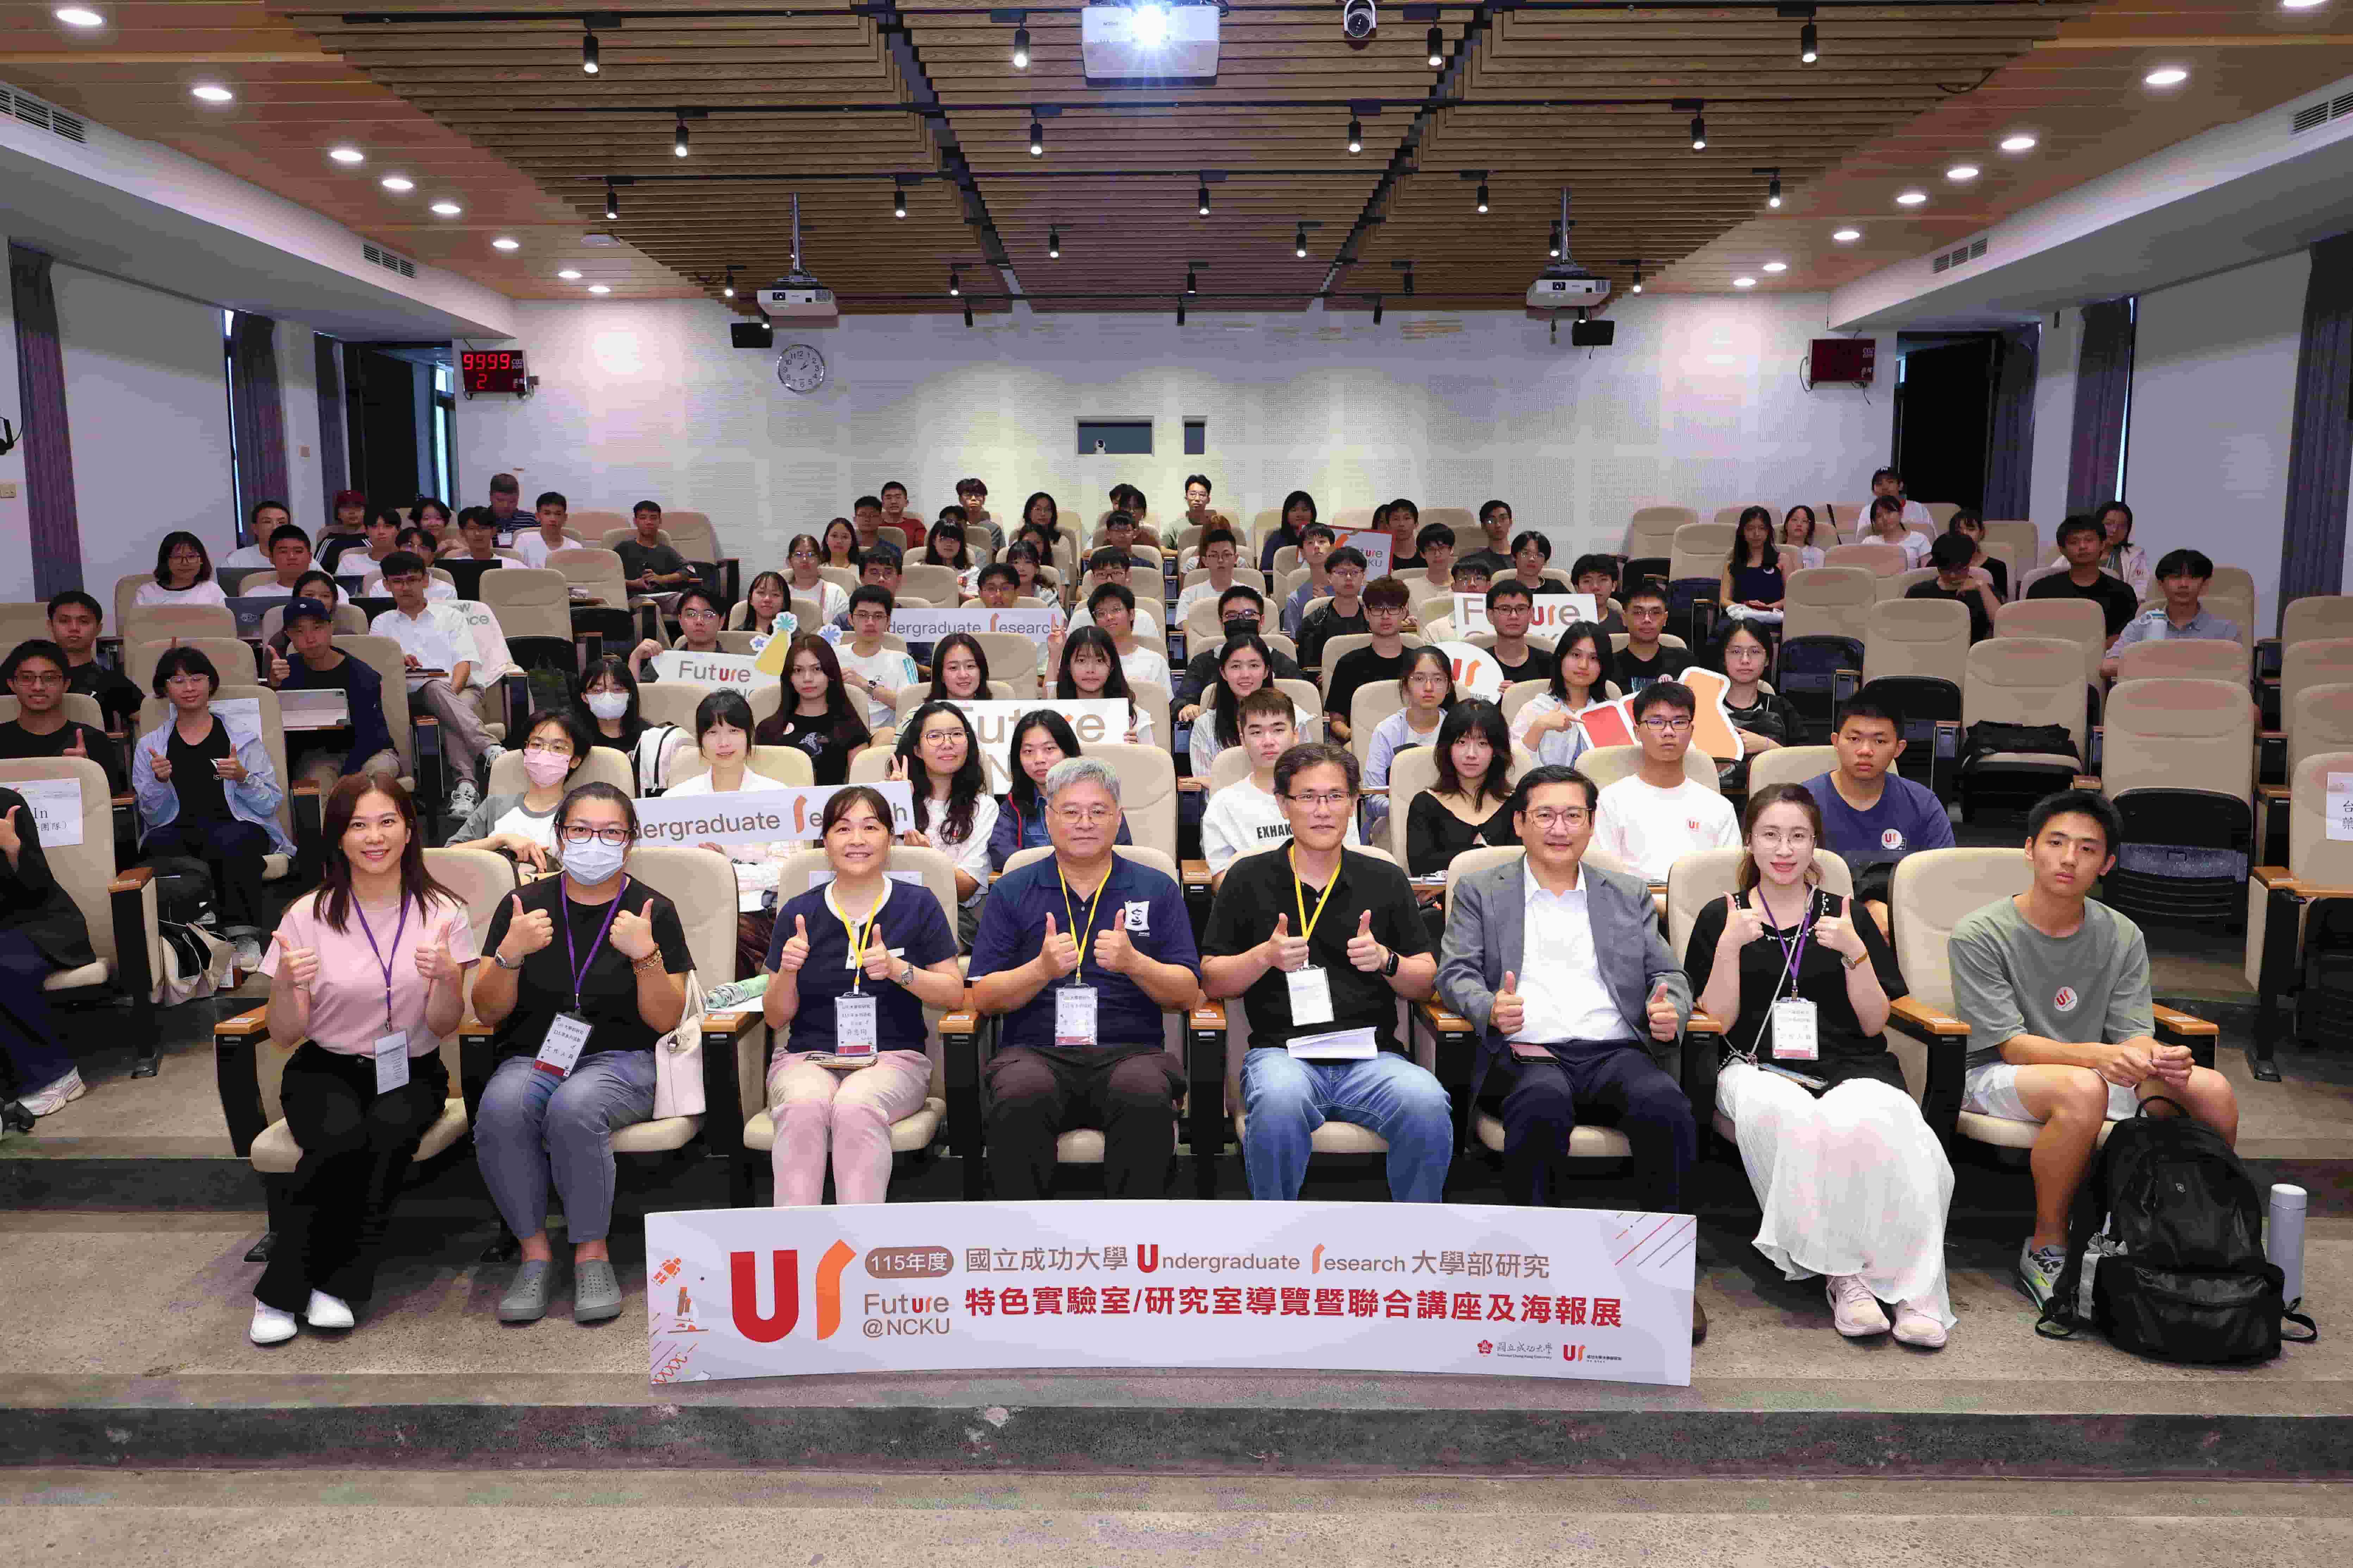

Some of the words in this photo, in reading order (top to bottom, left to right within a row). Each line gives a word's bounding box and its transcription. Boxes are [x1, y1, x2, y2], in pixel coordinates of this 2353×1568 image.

[463, 353, 510, 370] 9999
[1360, 547, 1383, 558] ture
[1463, 597, 1581, 626] Fure
[887, 621, 981, 637] dergraduate
[990, 613, 1052, 634] researc
[679, 660, 751, 682] Future
[37, 821, 68, 831] 團隊)
[634, 812, 780, 841] dergraduate
[871, 1251, 948, 1273] 115年度
[966, 1246, 1128, 1273] 國立成功大學
[1137, 1244, 1300, 1275] Undergraduate
[1411, 1250, 1549, 1278] 大學部研究
[865, 1293, 950, 1315] Future
[965, 1286, 1622, 1328] 特色實驗室/研究室導覽暨聯合講座及海報展
[863, 1318, 950, 1338] @NCKU
